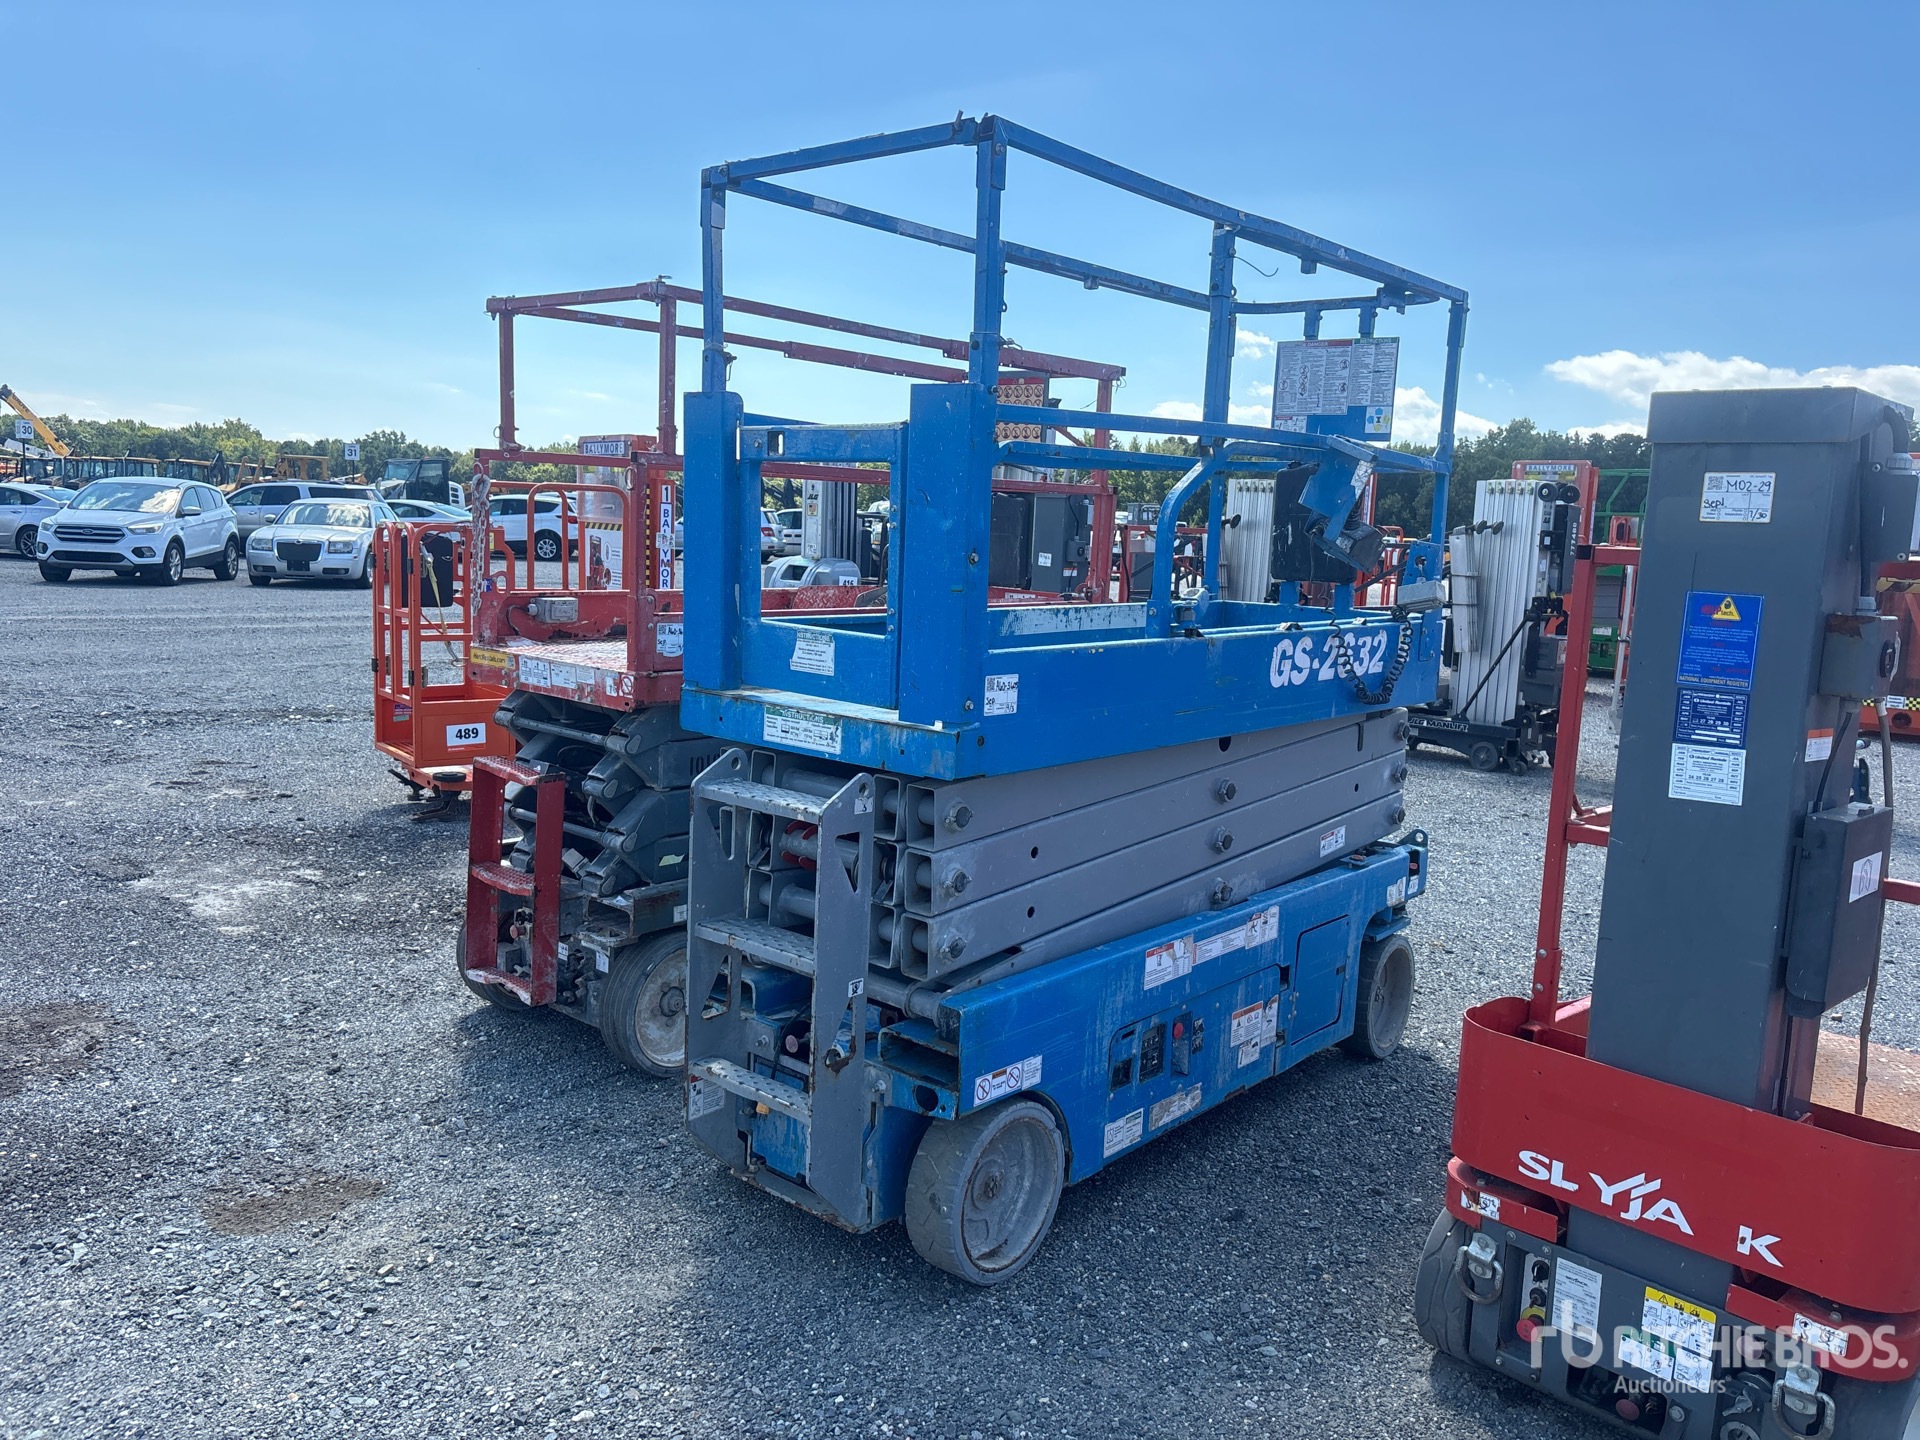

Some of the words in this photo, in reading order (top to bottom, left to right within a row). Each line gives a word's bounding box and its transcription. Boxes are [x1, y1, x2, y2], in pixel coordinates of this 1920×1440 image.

[21, 425, 33, 435] 30
[347, 448, 357, 457] 31
[584, 442, 624, 455] BALLYMORE
[1269, 629, 1388, 689] GS-2632
[1727, 679, 1748, 687] REGISTER
[1426, 720, 1469, 732] MANLIFT
[455, 727, 479, 740] 489
